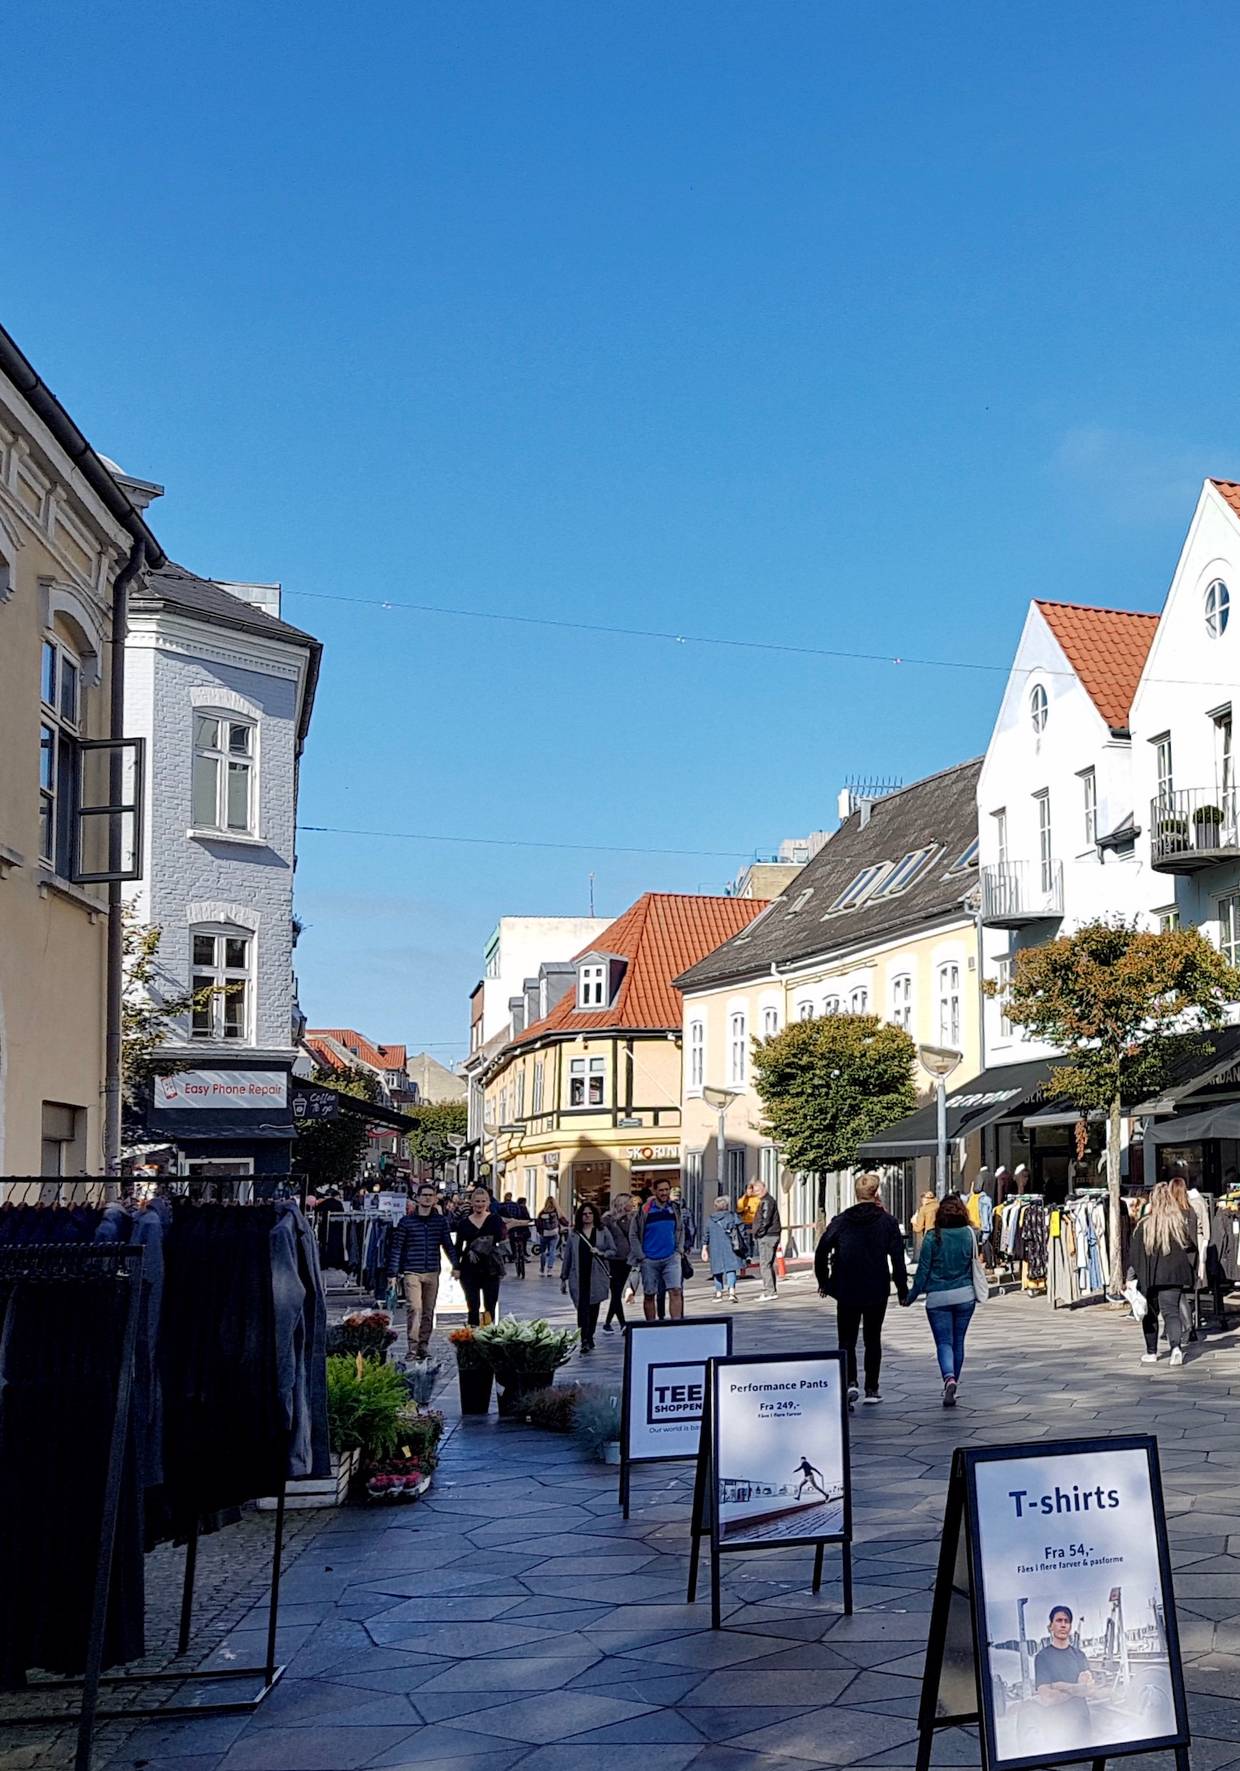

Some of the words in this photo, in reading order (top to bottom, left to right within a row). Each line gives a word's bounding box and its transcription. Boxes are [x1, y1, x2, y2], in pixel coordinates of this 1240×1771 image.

[184, 1083, 210, 1096] Easy
[212, 1083, 246, 1095] Phone
[248, 1083, 282, 1097] Repair
[309, 1093, 336, 1104] Coffee
[321, 1105, 333, 1116] go
[730, 1382, 797, 1393] Performance
[799, 1380, 829, 1390] Pants
[654, 1384, 703, 1404] TEE
[654, 1403, 702, 1414] SHOPPEN
[760, 1403, 774, 1411] Fra
[776, 1401, 801, 1410] 249,-
[663, 1425, 682, 1433] world
[1008, 1485, 1120, 1517] T-shirts
[1044, 1547, 1065, 1560] Fra
[1069, 1543, 1095, 1557] 54,-
[1040, 1563, 1057, 1571] flere
[1058, 1561, 1081, 1569] farver
